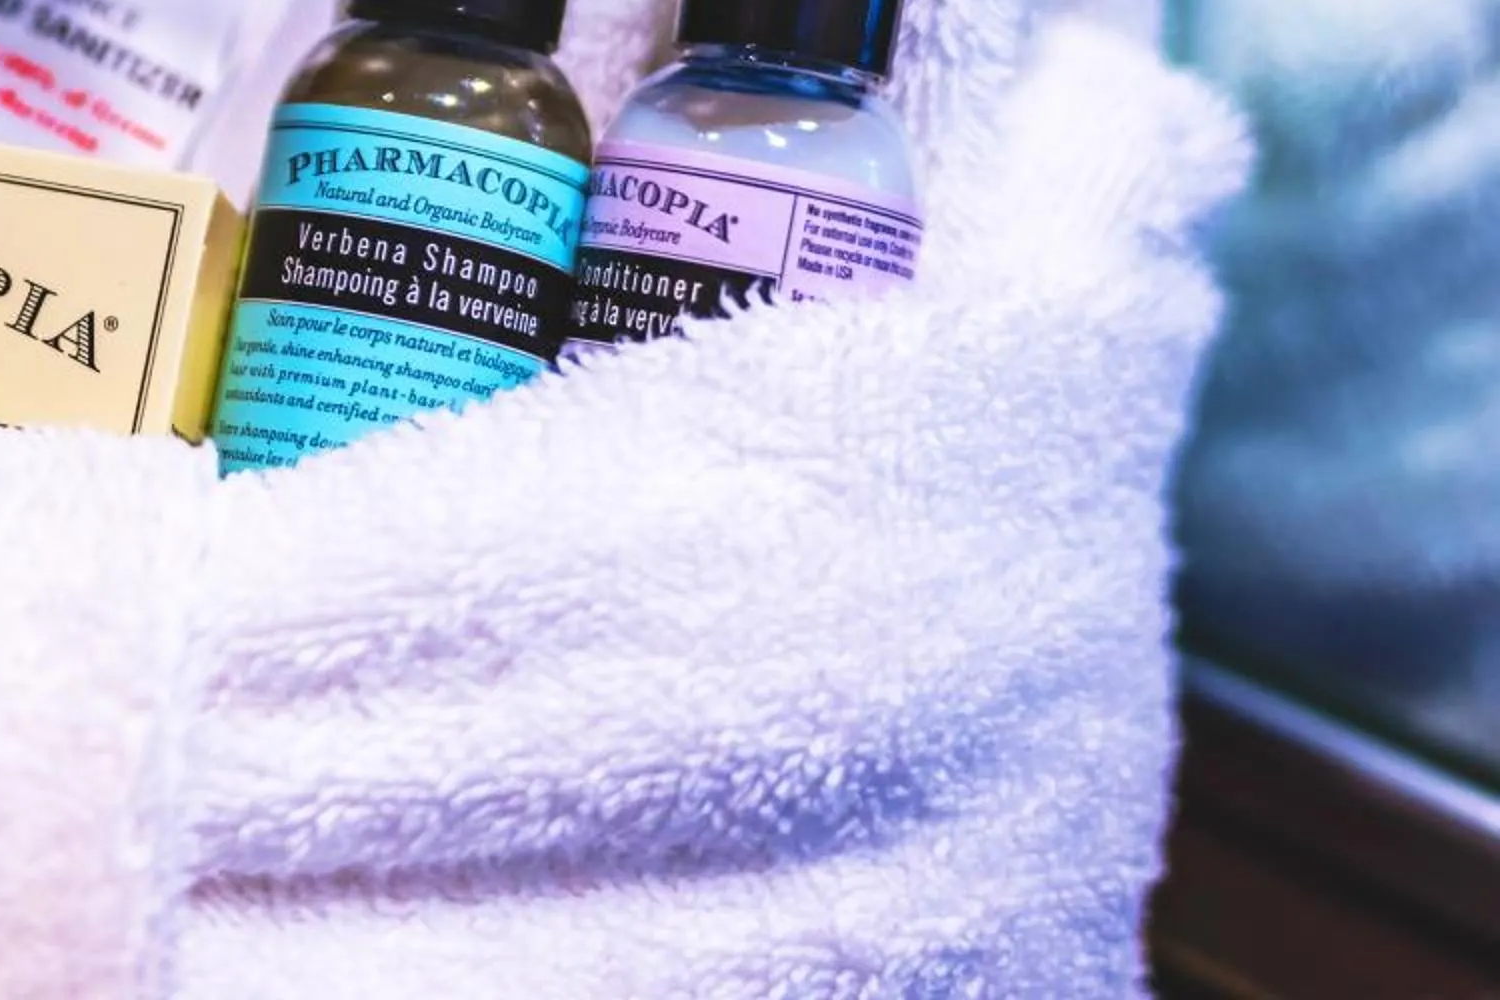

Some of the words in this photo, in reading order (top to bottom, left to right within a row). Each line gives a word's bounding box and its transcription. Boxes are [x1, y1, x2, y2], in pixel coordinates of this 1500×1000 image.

[286, 145, 577, 248] PHARMACOPIA
[314, 180, 375, 205] Natural
[376, 190, 410, 211] and
[413, 196, 479, 224] Organic
[480, 211, 545, 246] Bodycare
[620, 217, 682, 246] Bodycare
[298, 222, 407, 265] Verbena
[423, 243, 538, 299] Shampoo
[835, 264, 853, 280] USA
[280, 256, 400, 305] Shampoing
[404, 274, 421, 304] à
[428, 281, 450, 312] la
[459, 295, 539, 337] verveine
[603, 298, 621, 326] la
[294, 317, 331, 336] pour
[332, 317, 349, 336] le
[349, 324, 393, 348] corps
[395, 334, 457, 361] naturel
[457, 348, 472, 363] et
[249, 362, 277, 379] with
[276, 368, 348, 391] premium
[278, 340, 316, 359] shine
[317, 348, 395, 378] enhancing
[395, 361, 461, 390] shampoo
[285, 394, 316, 411] and
[316, 401, 381, 423] certified
[239, 420, 308, 449] shampoing
